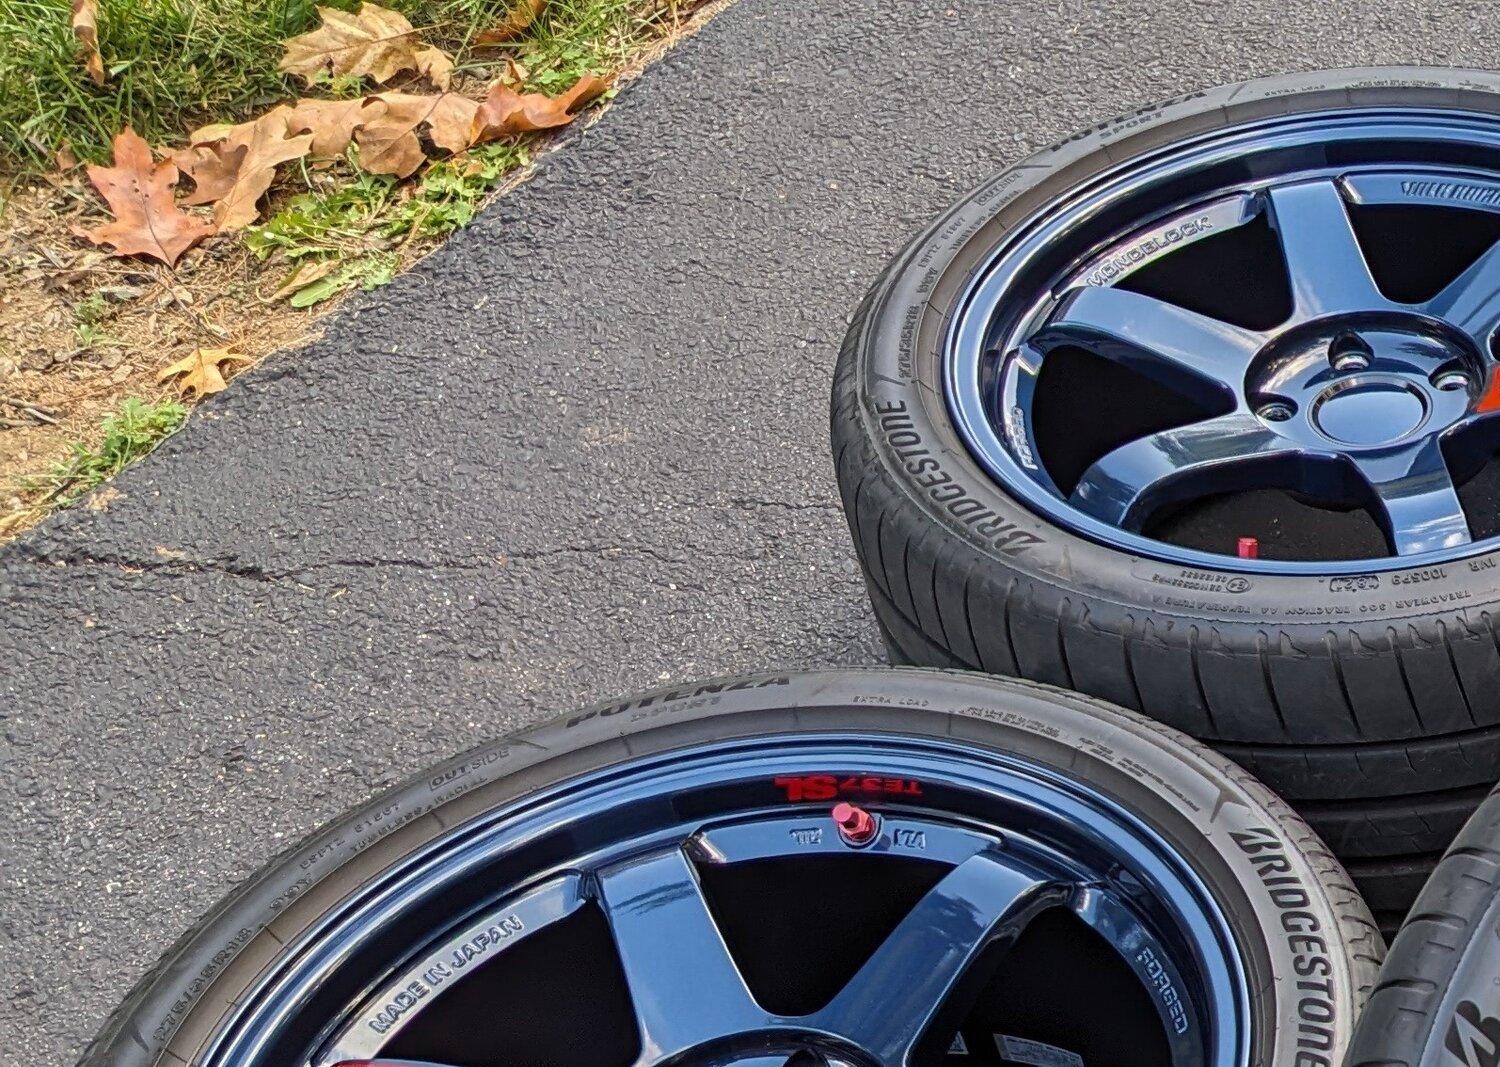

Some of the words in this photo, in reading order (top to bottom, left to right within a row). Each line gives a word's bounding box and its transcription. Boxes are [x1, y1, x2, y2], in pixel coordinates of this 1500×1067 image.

[1086, 215, 1213, 288] MONOBLOCK
[875, 400, 1047, 556] BRIDGESTONE
[429, 749, 510, 789] OUTSIDE
[369, 982, 431, 1034] MADE
[424, 960, 453, 988] IN
[451, 914, 525, 969] JAPAN
[1135, 947, 1189, 1034] FORGED
